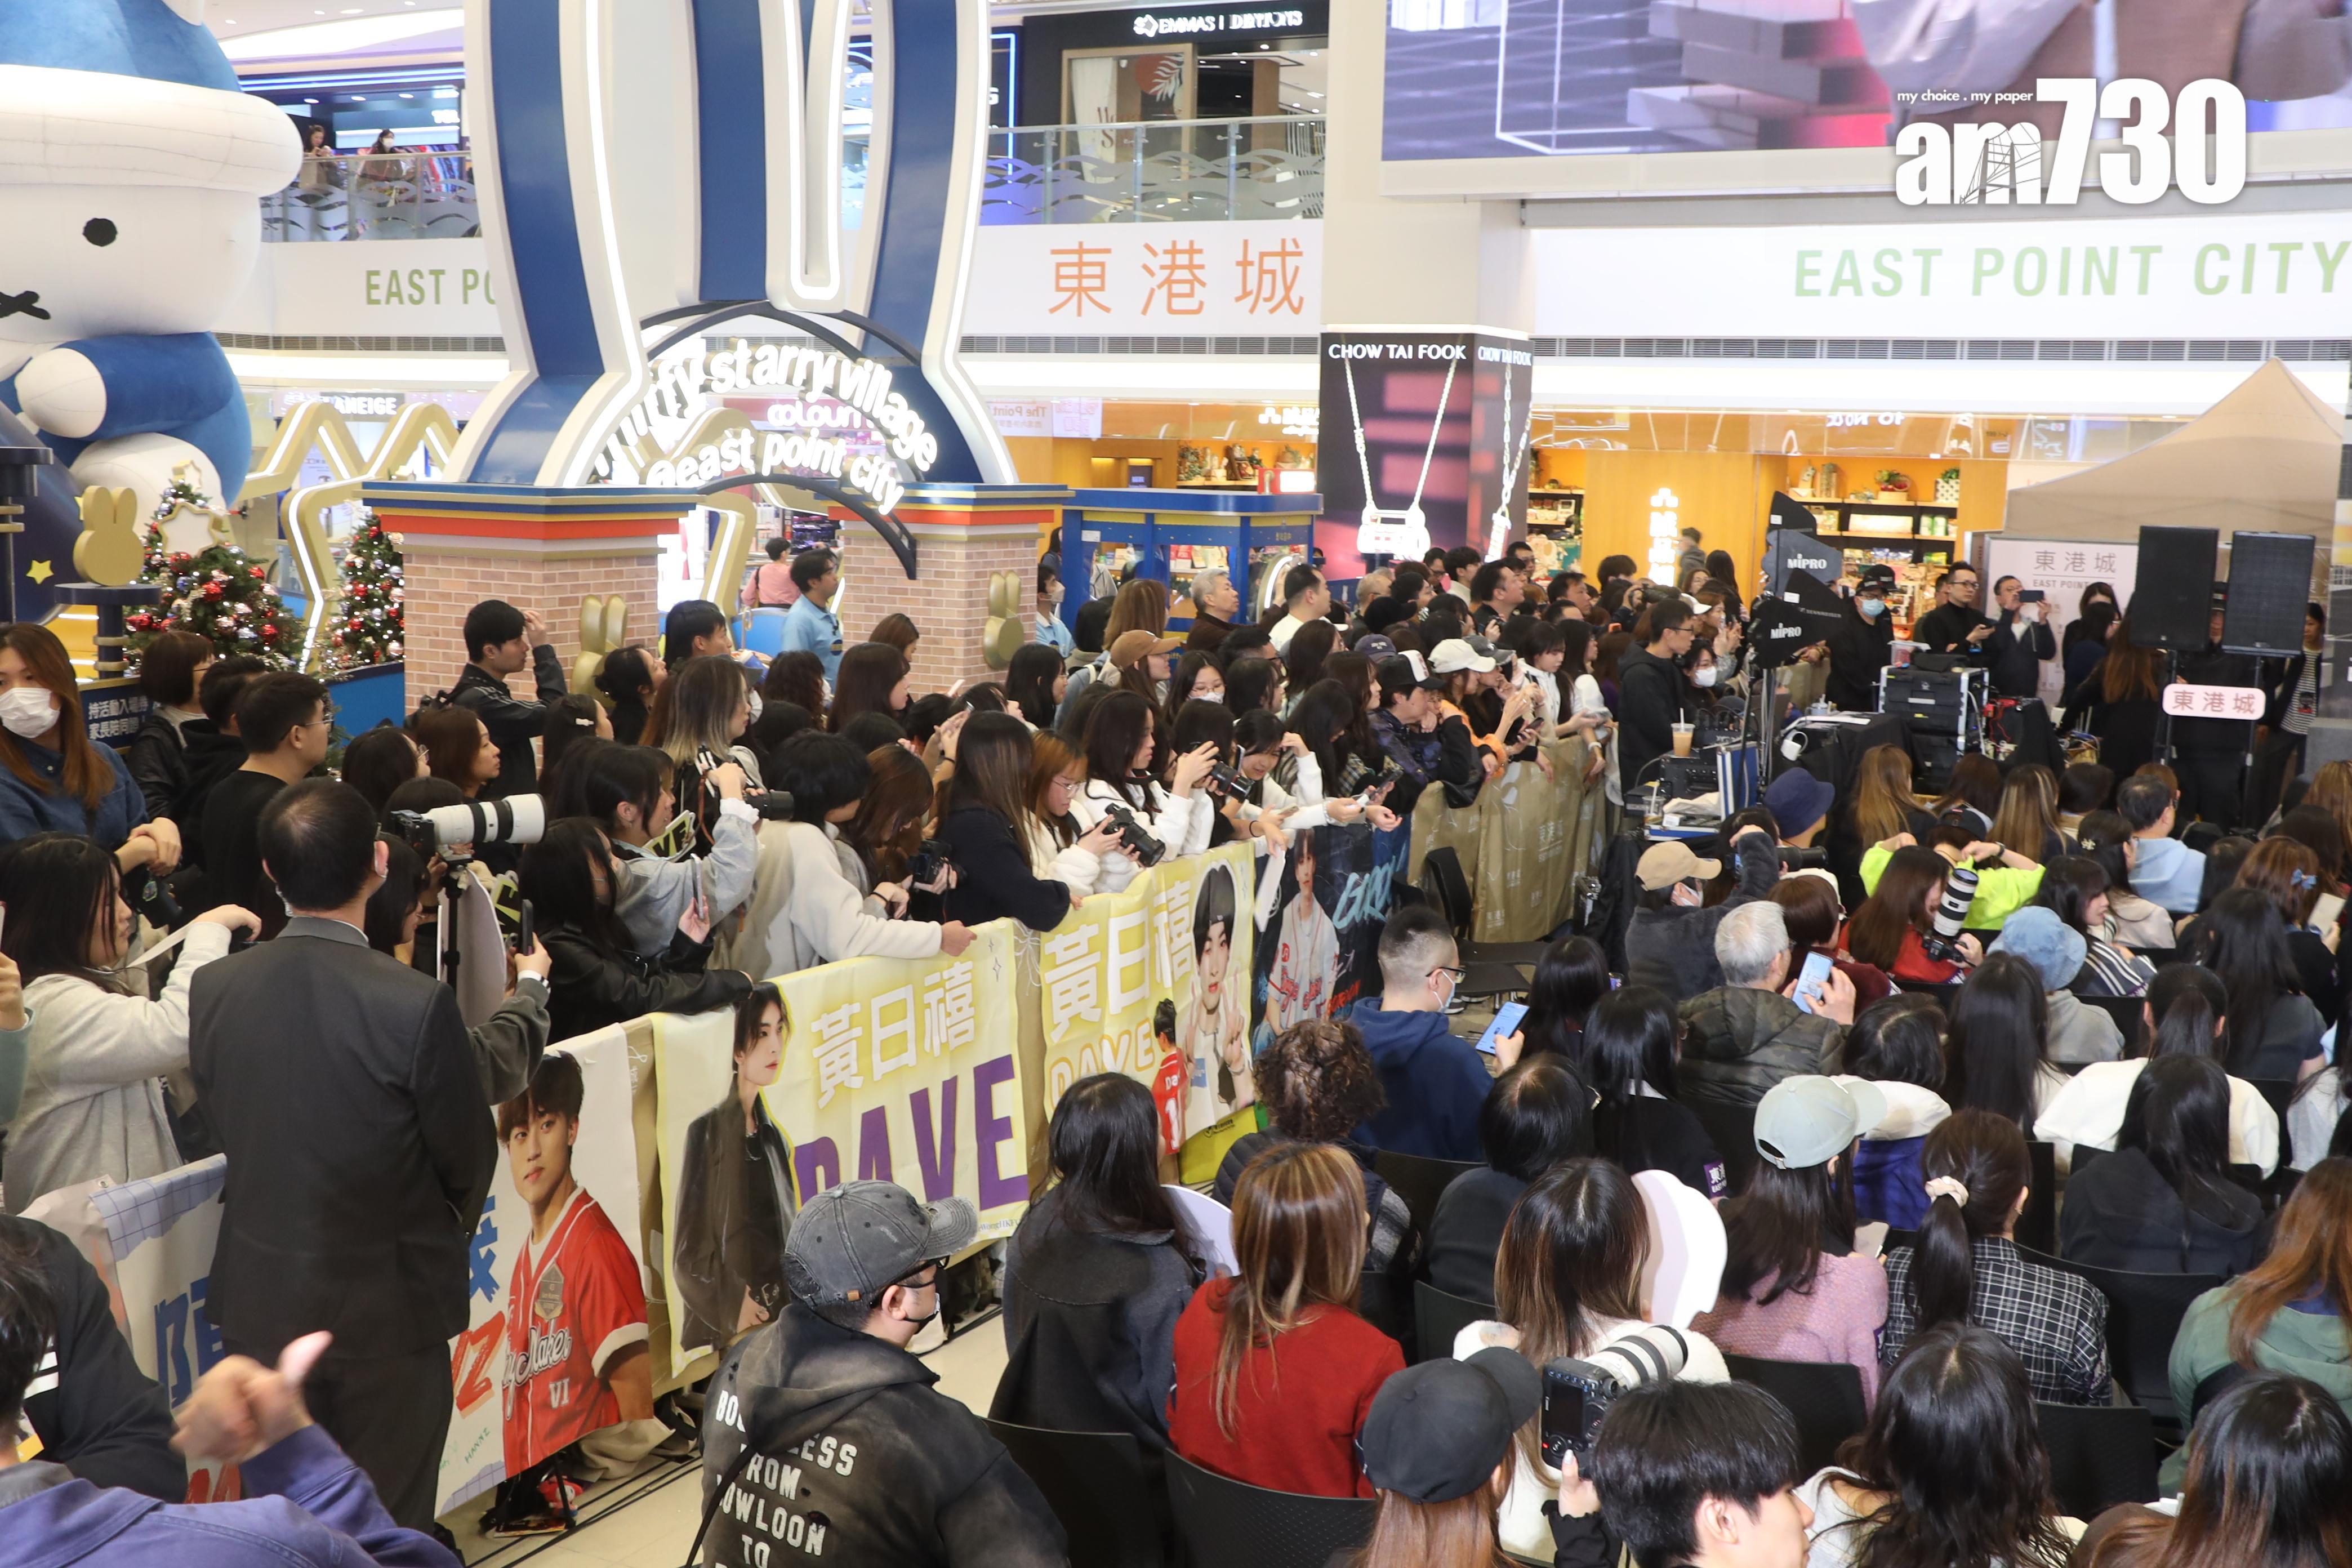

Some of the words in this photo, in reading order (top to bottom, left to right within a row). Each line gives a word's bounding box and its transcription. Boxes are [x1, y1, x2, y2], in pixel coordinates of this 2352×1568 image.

[1048, 238, 1305, 318] 東港城
[1794, 247, 1943, 297] EAST
[1971, 244, 2163, 297] POINT
[2193, 240, 2352, 296] CITY
[366, 269, 446, 306] EAST
[1328, 344, 1383, 359] CHOW
[1386, 344, 1413, 359] TAI
[1418, 344, 1467, 360] FOOK
[1478, 346, 1500, 362] CHOW
[1512, 350, 1532, 366] FOOK
[334, 395, 397, 415] ANEIGE
[709, 338, 838, 403] starry
[839, 358, 939, 471] village
[761, 427, 847, 477] point
[849, 455, 906, 515] city
[2033, 550, 2117, 573] 東港城
[2033, 580, 2057, 589] EAST
[2172, 689, 2256, 715] 東港城
[1044, 880, 1193, 1044] 黃日禧
[810, 961, 976, 1110] 黃日禧
[1165, 1072, 1182, 1092] Da
[549, 1378, 570, 1409] VI
[740, 1443, 802, 1500] ROM
[716, 1473, 826, 1556] OWLOON
[741, 1534, 771, 1568] TO
